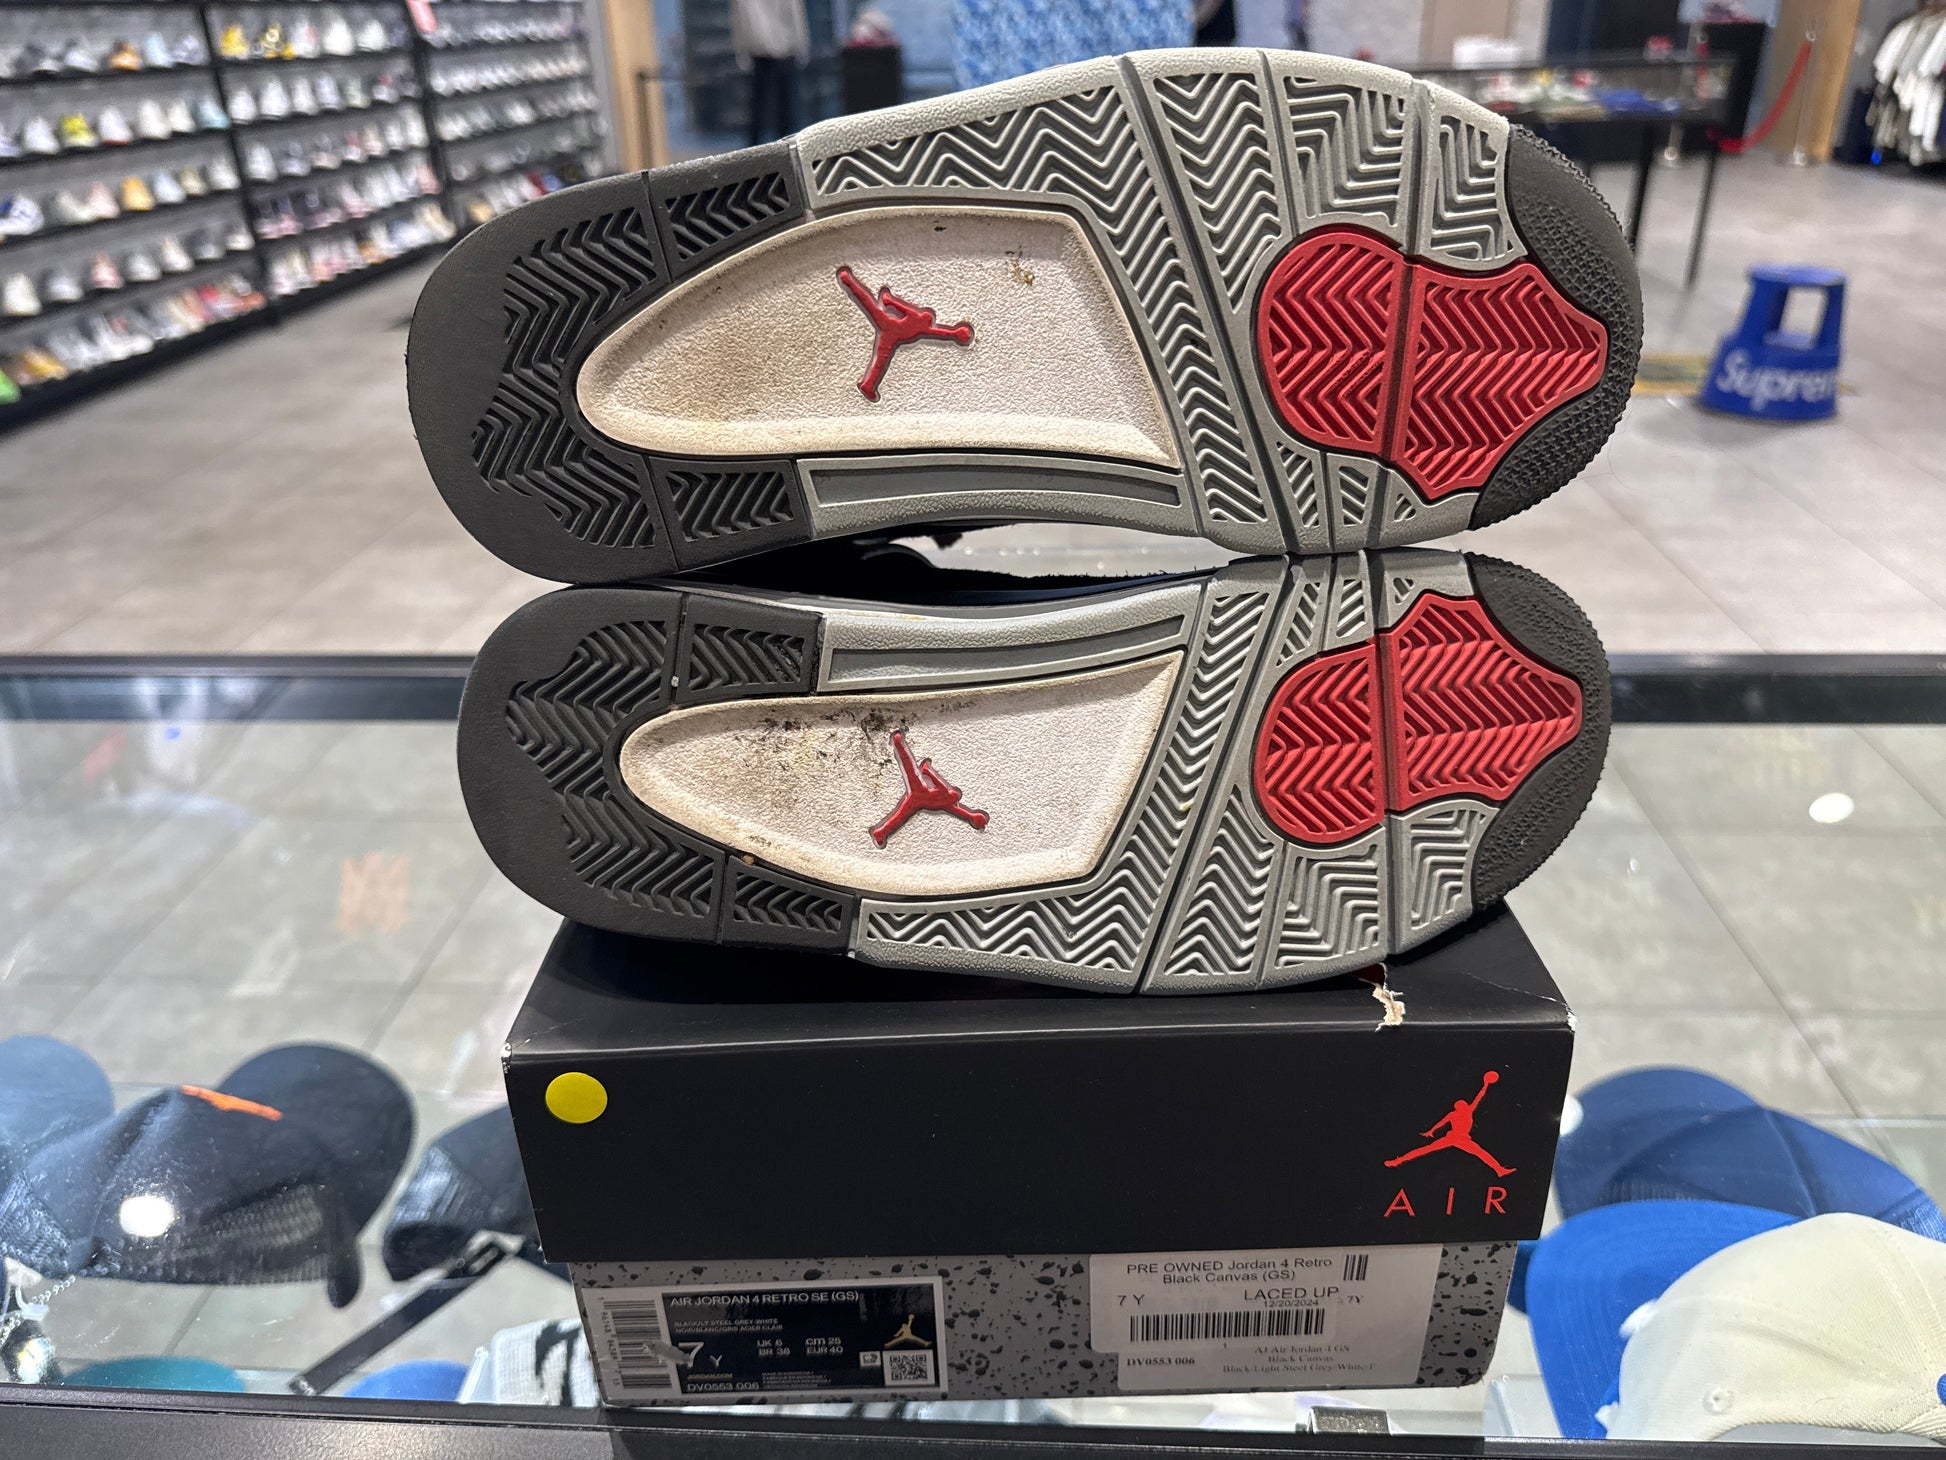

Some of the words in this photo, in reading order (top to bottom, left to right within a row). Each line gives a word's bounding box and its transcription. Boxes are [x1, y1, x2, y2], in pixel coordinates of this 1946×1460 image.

[1384, 1186, 1508, 1218] AIR
[1127, 1264, 1158, 1274] PRE
[1163, 1260, 1223, 1273] OWNED
[1228, 1259, 1276, 1270] Jordan
[1280, 1258, 1289, 1268] 4
[1294, 1257, 1333, 1268] Retro
[1163, 1274, 1200, 1284] Black
[1205, 1271, 1258, 1282] Canvas
[1262, 1269, 1296, 1282] (GS)
[670, 1295, 693, 1306] AIR
[695, 1294, 750, 1305] JORDAN
[752, 1294, 760, 1304] 4
[762, 1292, 809, 1303] RETRO
[811, 1291, 829, 1302] SE
[831, 1290, 859, 1302] (GS)
[1244, 1287, 1307, 1301] LACED
[1313, 1286, 1339, 1298] UP
[1118, 1295, 1127, 1306] 7
[1133, 1294, 1145, 1305] Y
[1264, 1299, 1319, 1308] 12/20/2024
[756, 1339, 772, 1348] UK
[775, 1338, 783, 1347] 6
[805, 1337, 826, 1346] cm
[827, 1336, 842, 1346] 25
[678, 1341, 705, 1368] 7
[709, 1354, 723, 1368] Y
[759, 1347, 774, 1357] BR
[776, 1347, 791, 1356] 38
[806, 1346, 828, 1355] EUR
[829, 1345, 843, 1354] 40
[736, 1381, 760, 1391] 006
